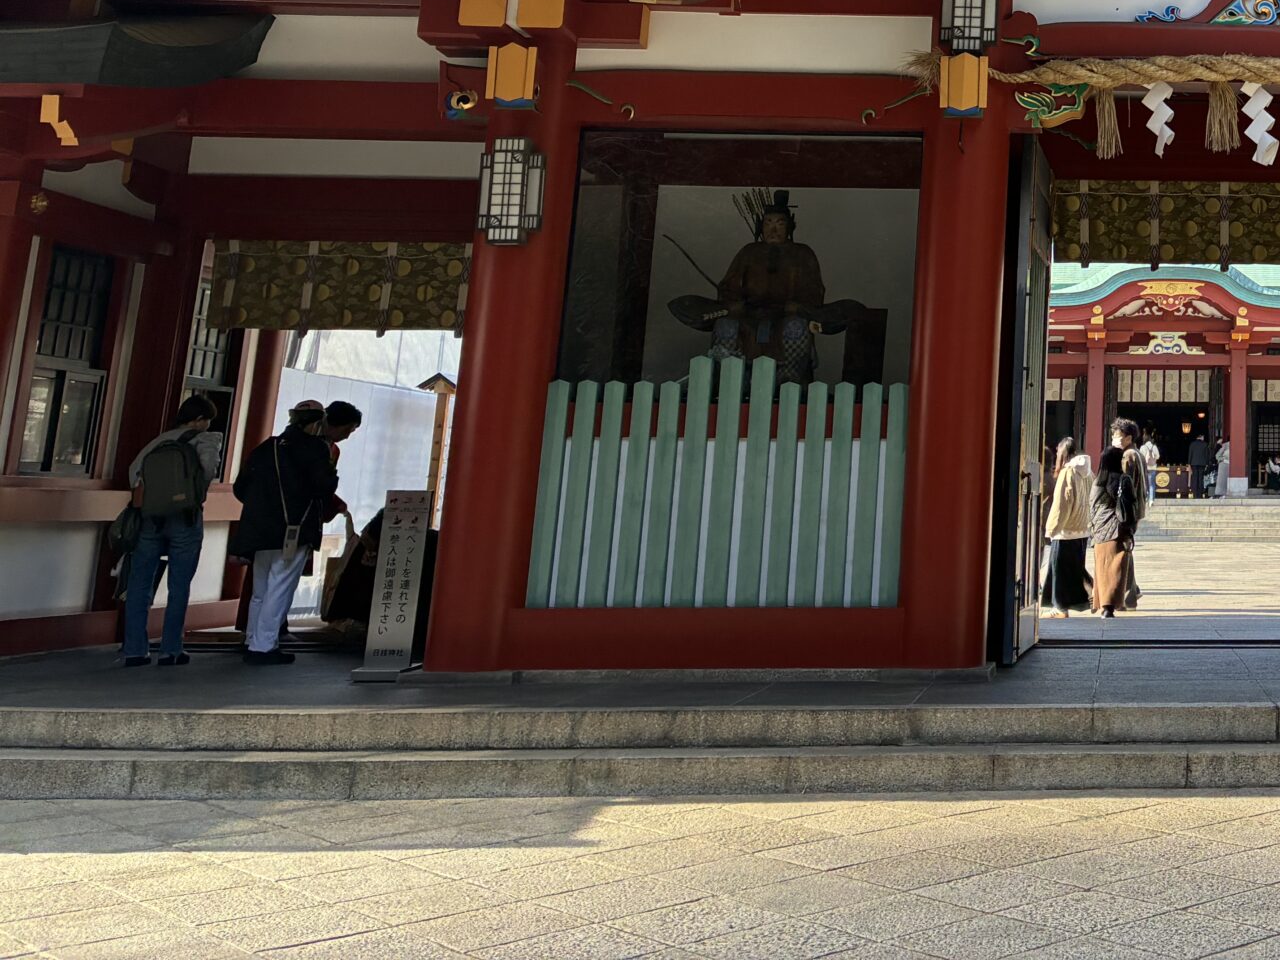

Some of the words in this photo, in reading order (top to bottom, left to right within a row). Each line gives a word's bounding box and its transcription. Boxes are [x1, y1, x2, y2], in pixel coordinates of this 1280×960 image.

[395, 534, 417, 624] ペットを連れての
